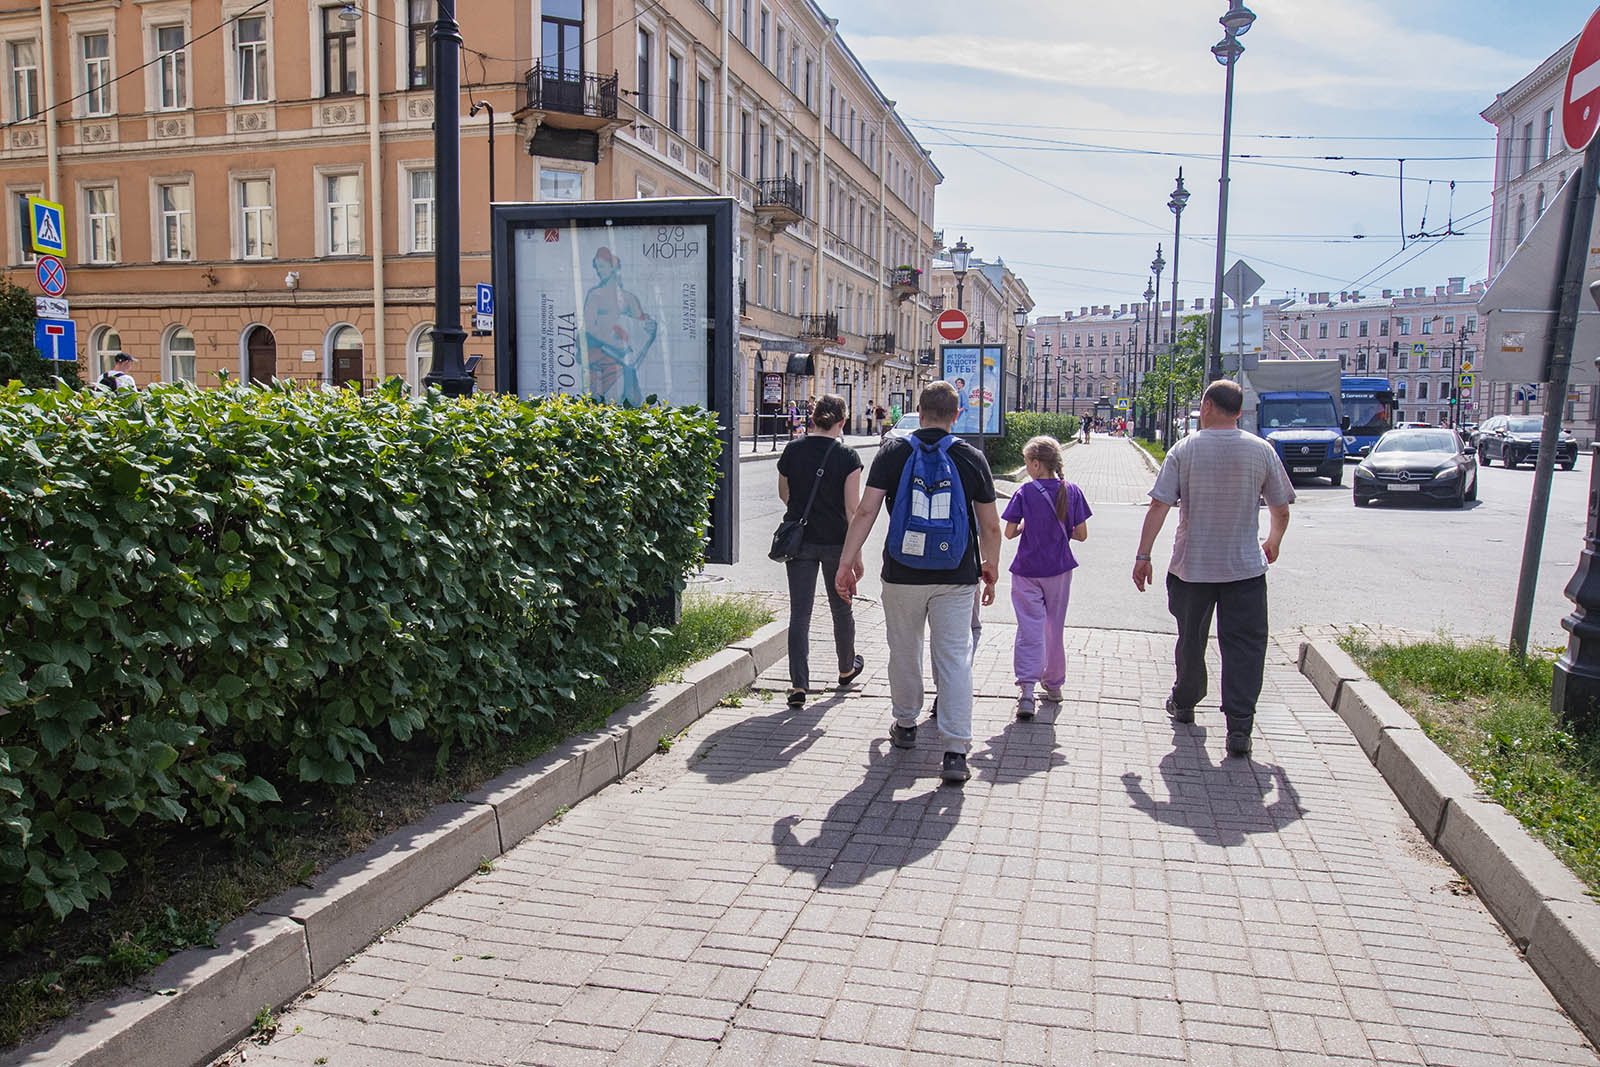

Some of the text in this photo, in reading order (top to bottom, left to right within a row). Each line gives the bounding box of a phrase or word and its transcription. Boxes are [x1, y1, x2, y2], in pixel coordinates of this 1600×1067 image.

[657, 226, 685, 243] 8/9
[642, 242, 699, 259] ИЮНЯ
[557, 312, 577, 368] САДА
